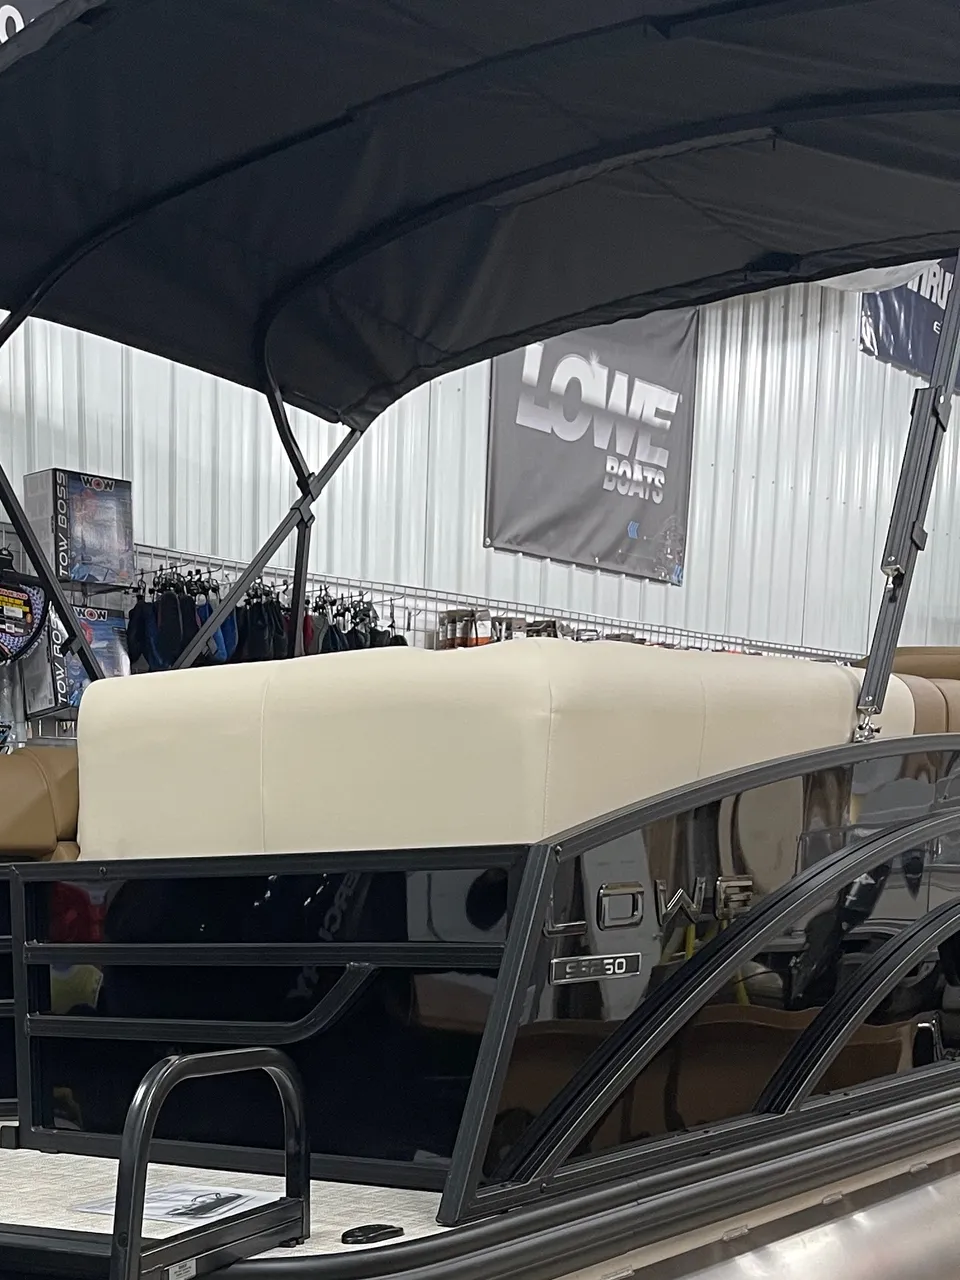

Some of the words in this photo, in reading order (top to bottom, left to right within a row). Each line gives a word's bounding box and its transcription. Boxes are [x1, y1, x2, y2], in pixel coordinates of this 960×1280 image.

[516, 341, 680, 468] LOWE
[56, 471, 68, 528] BOSS
[81, 475, 115, 491] WOW
[603, 456, 665, 504] BOATS
[59, 533, 68, 577] TOW
[73, 606, 107, 621] WOW
[54, 662, 67, 703] TOW
